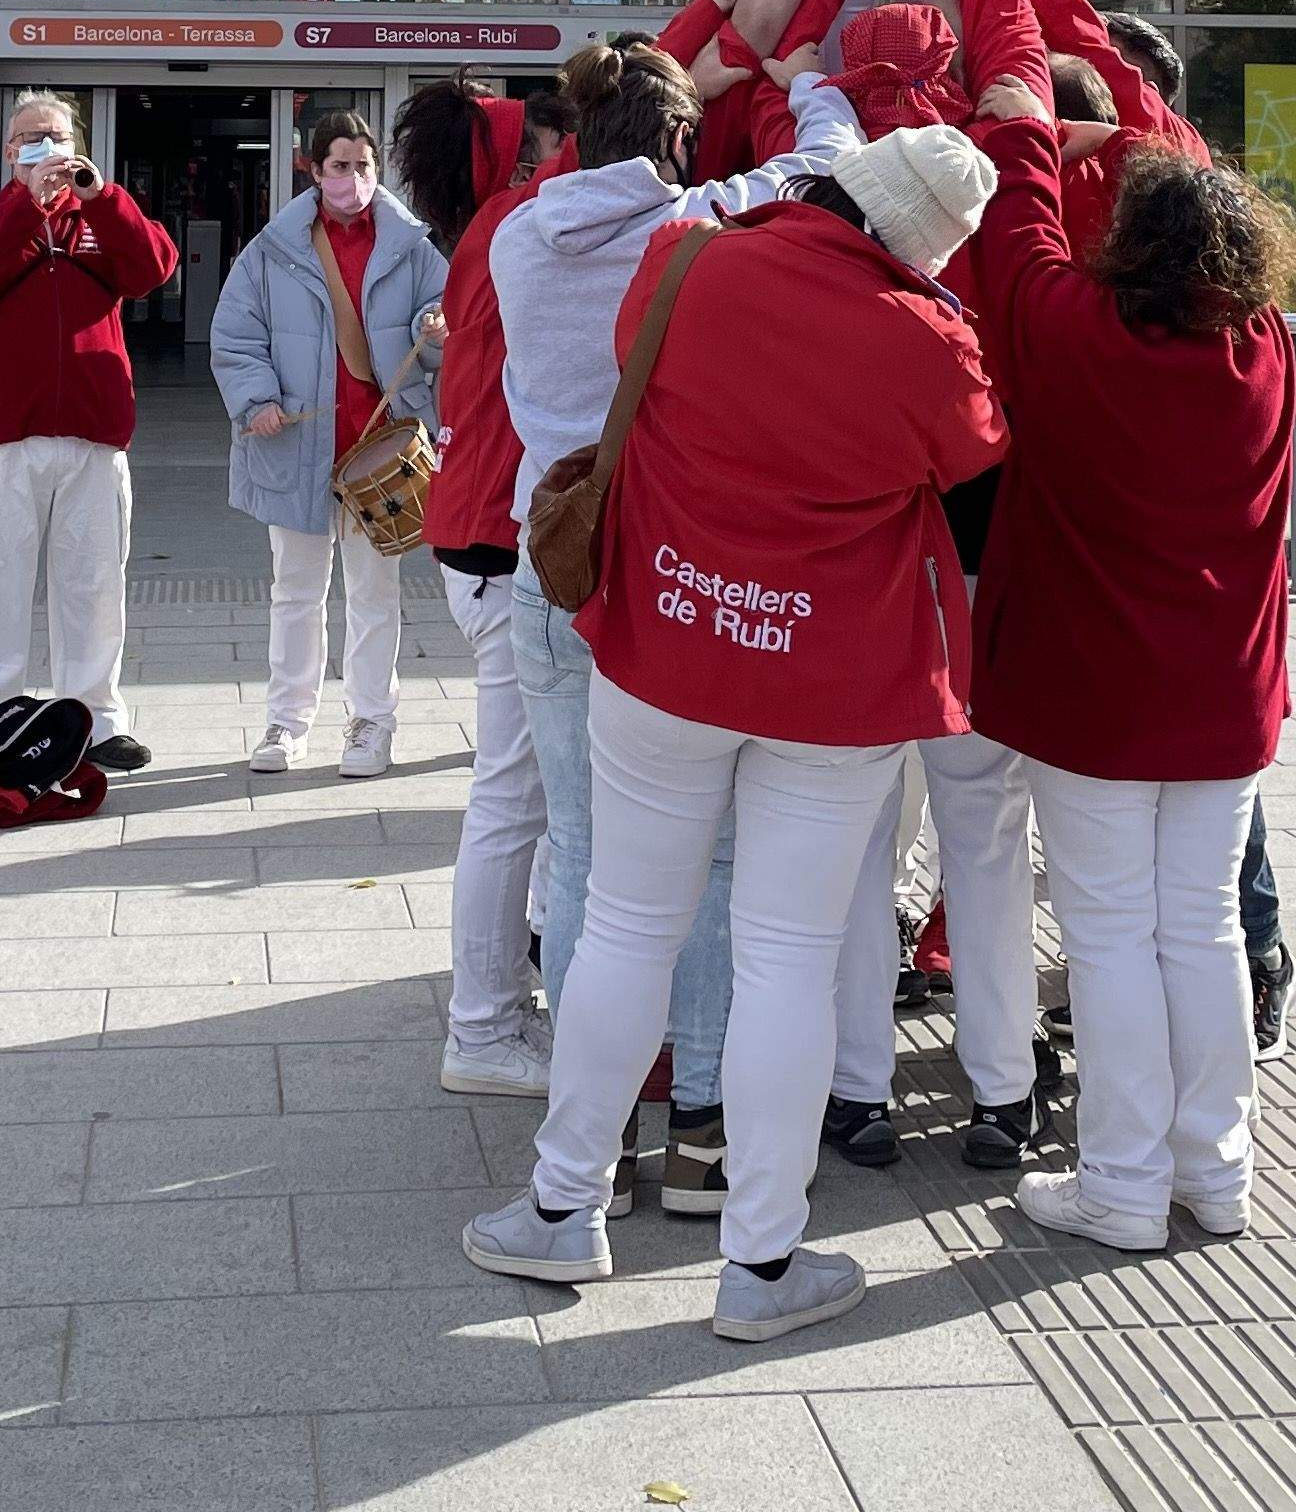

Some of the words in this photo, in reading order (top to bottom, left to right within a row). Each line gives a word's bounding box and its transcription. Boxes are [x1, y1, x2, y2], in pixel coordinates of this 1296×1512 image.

[23, 24, 46, 41] S1
[74, 25, 163, 42] Barcelona
[180, 26, 255, 43] Terrassa
[306, 27, 332, 44] S7
[375, 27, 460, 45] Barcelona
[478, 27, 517, 44] Rubí
[654, 544, 812, 617] Castellers
[658, 588, 697, 625] de
[714, 607, 795, 653] Rubí
